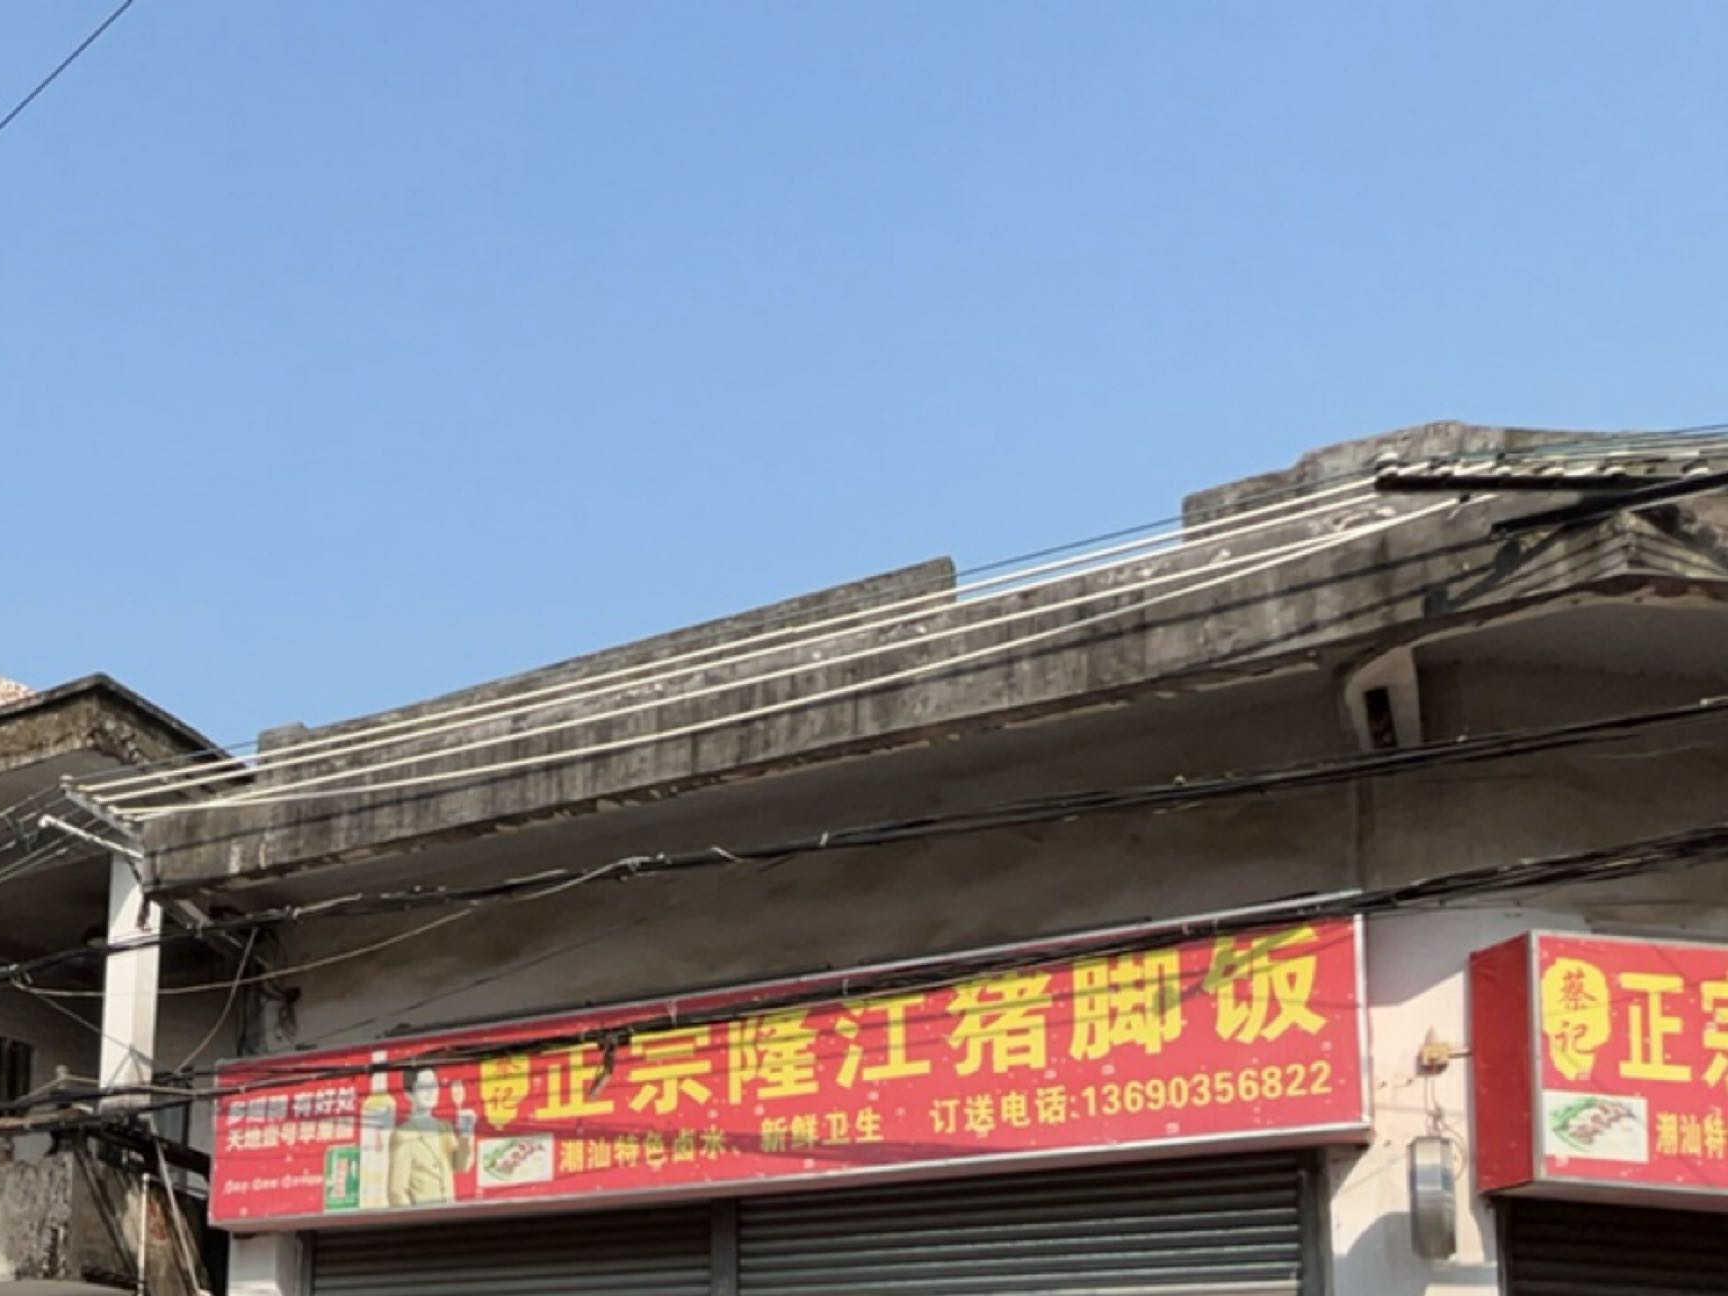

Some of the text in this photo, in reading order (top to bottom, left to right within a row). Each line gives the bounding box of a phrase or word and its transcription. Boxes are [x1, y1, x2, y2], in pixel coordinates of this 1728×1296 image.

[535, 924, 1326, 1119] 正宗隆江猪脚饭
[1555, 965, 1599, 1054] 蔡记
